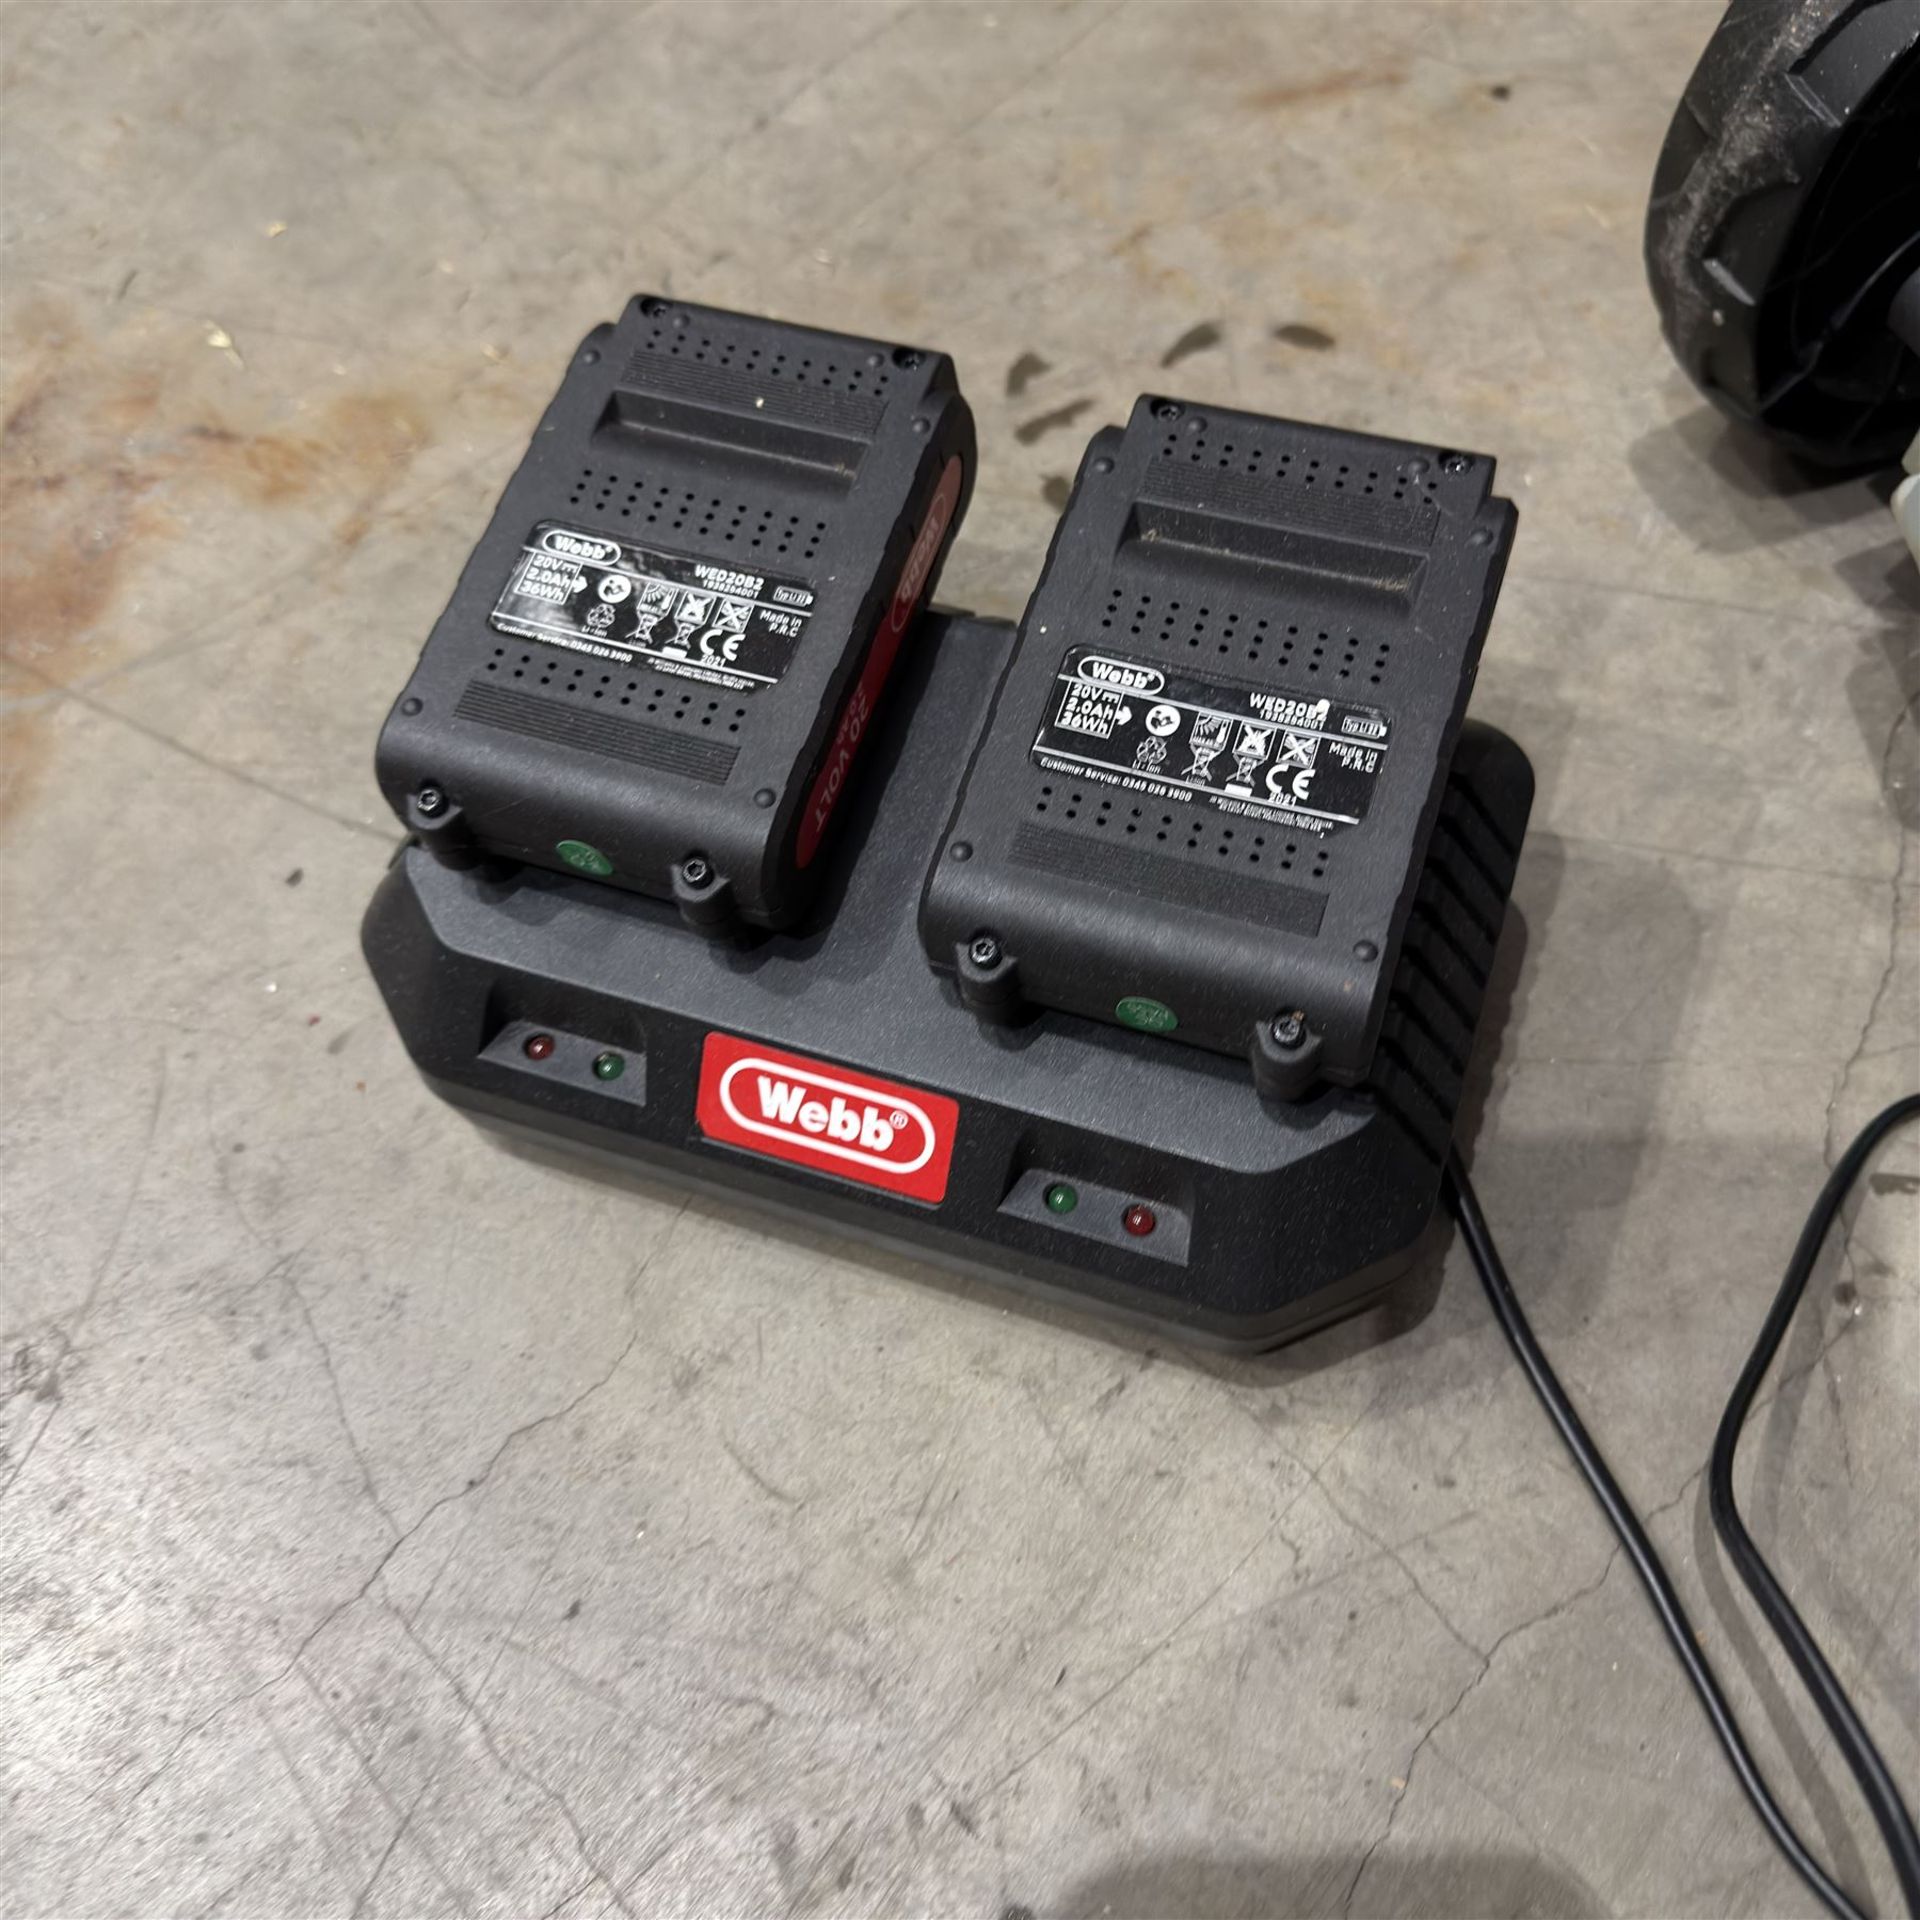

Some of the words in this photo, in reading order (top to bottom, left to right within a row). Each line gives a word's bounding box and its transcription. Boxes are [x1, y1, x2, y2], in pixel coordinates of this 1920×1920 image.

[525, 568, 571, 589] 2.0Ah
[694, 564, 765, 591] WED20B2
[520, 581, 565, 601] 36Wh
[760, 609, 790, 624] Made
[791, 617, 802, 627] in
[496, 622, 539, 640] Customer
[1065, 696, 1114, 720] 2.0Ah
[1061, 711, 1109, 735] 36Wh
[1329, 742, 1364, 758] Made
[1365, 747, 1378, 763] in
[1040, 756, 1083, 776] Customer
[815, 749, 849, 832] VOLT
